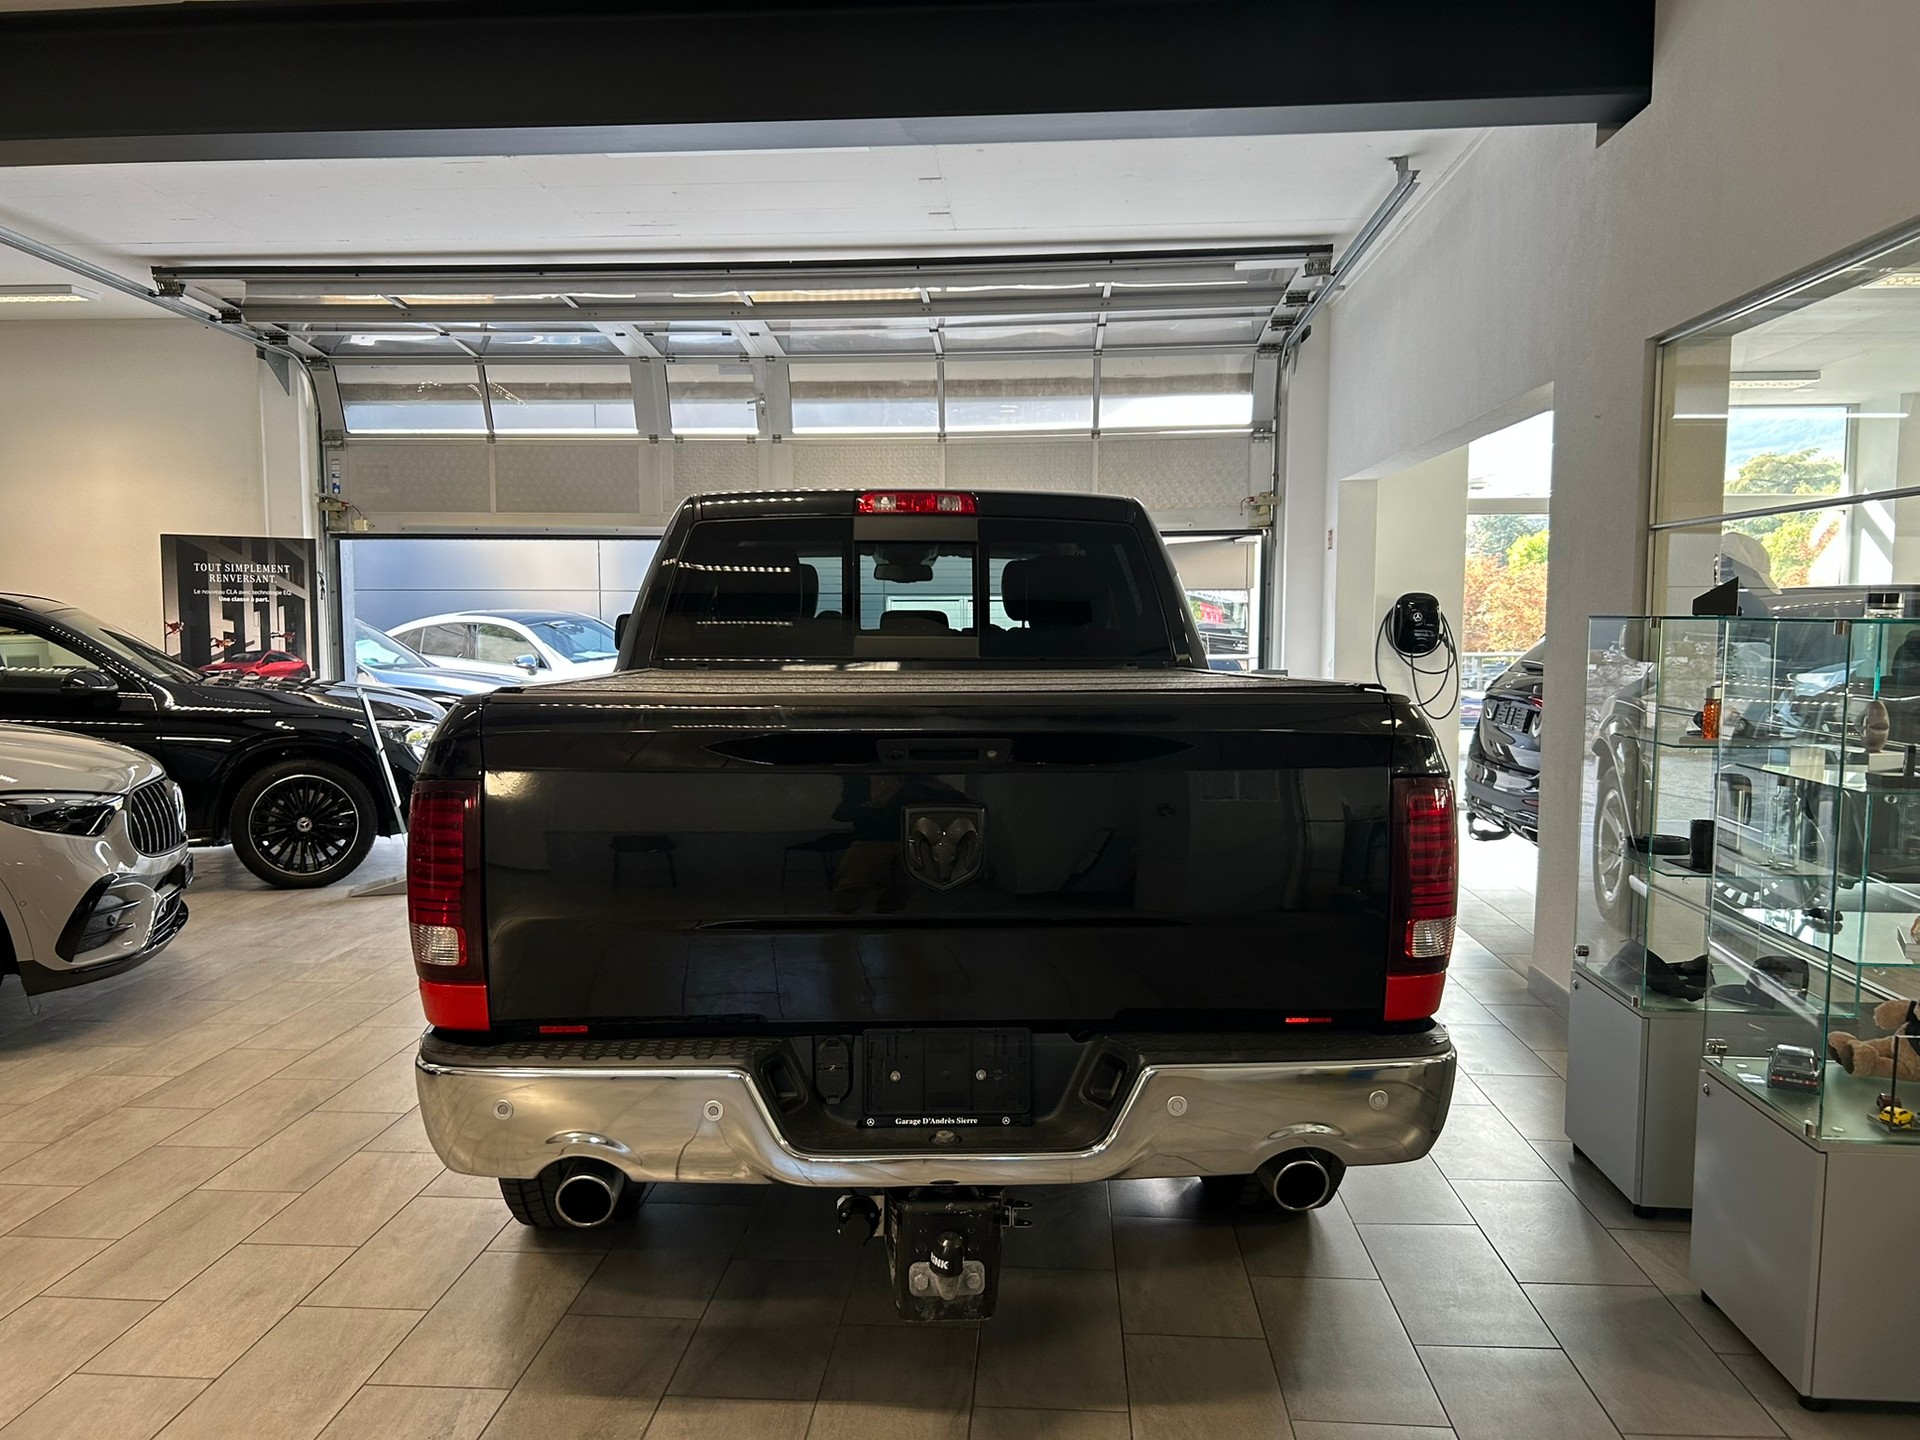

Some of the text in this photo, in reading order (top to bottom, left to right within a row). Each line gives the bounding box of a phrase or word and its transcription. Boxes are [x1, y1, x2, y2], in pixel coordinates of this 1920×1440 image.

[194, 563, 290, 573] TOUT SIMPLEMENT
[209, 573, 278, 584] RENVERSANT.
[252, 589, 282, 597] technologie
[895, 1117, 921, 1126] Garage
[922, 1117, 955, 1125] D'Andrès
